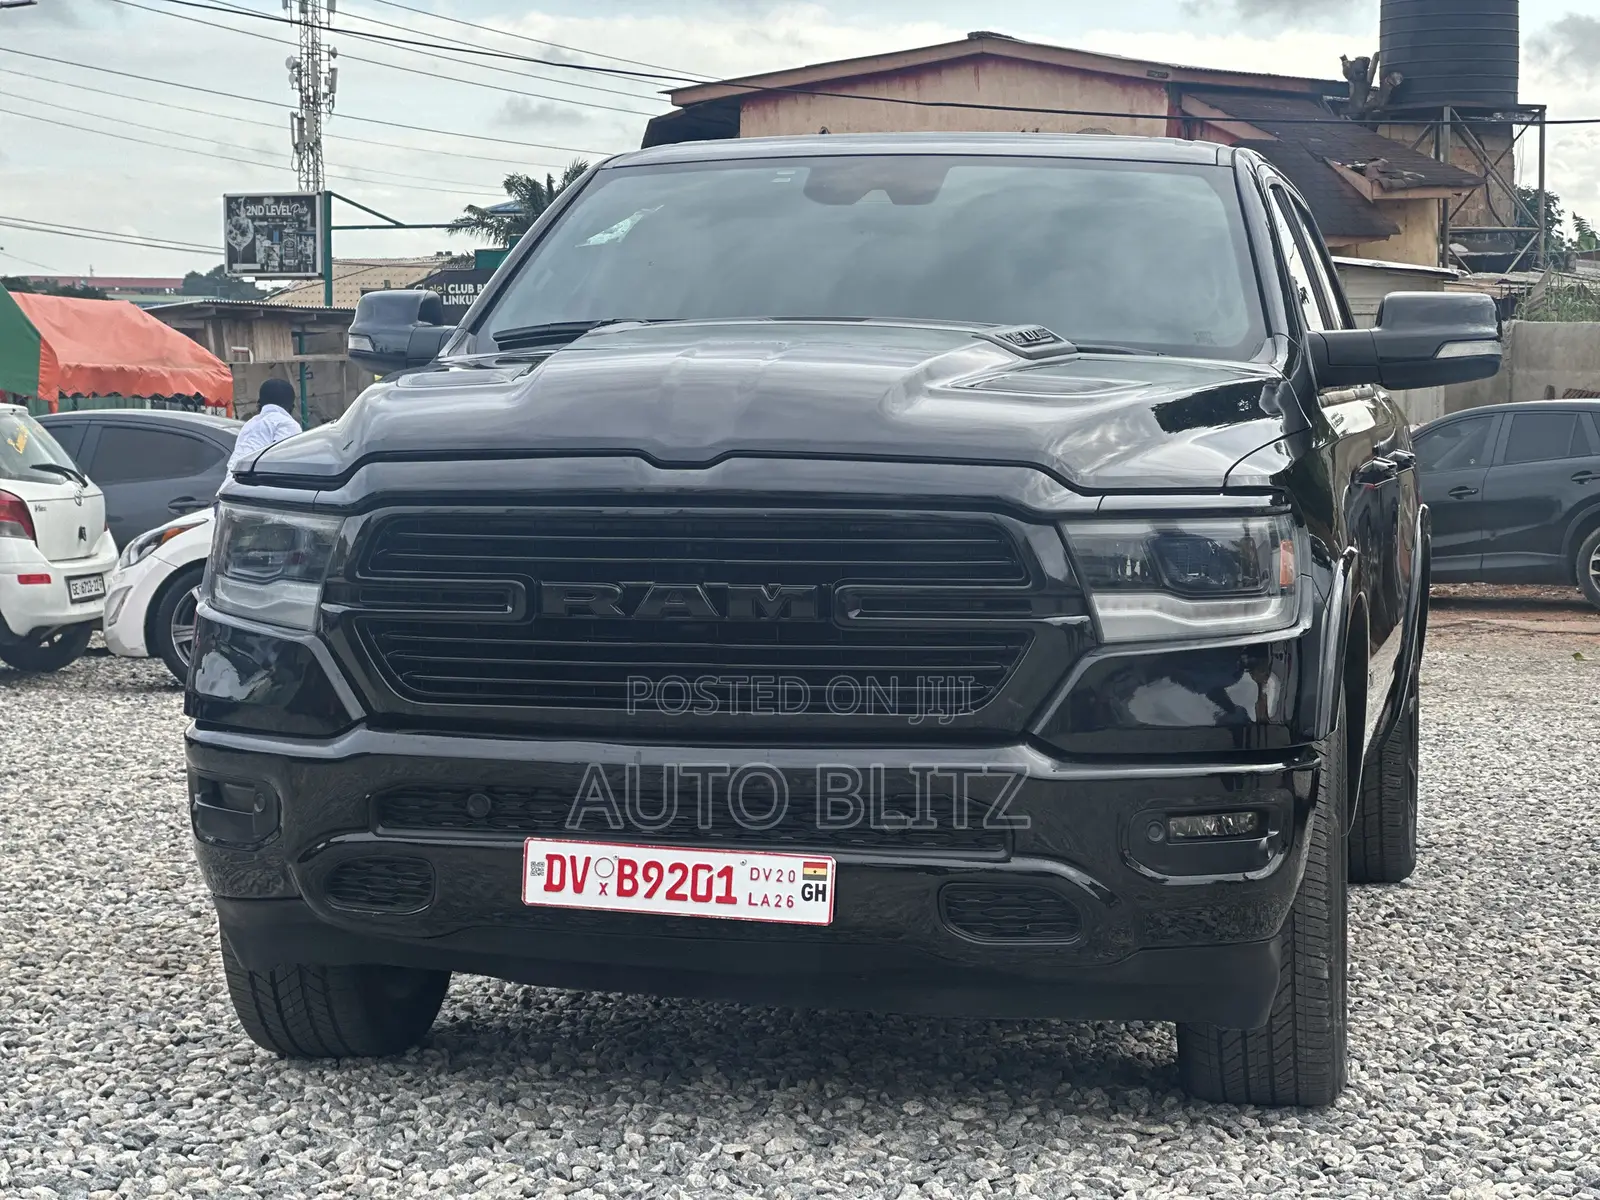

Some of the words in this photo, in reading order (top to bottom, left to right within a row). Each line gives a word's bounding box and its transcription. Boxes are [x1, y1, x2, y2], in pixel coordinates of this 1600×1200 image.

[246, 205, 264, 216] 2ND
[266, 202, 292, 216] LEVEL
[292, 204, 308, 217] Pub
[448, 284, 474, 294] CLUB
[477, 284, 487, 294] B
[541, 581, 819, 619] RAM
[543, 853, 592, 894] DV
[616, 858, 738, 905] B9201
[749, 867, 796, 883] DV20
[748, 892, 794, 908] LA26
[801, 883, 827, 902] GH
